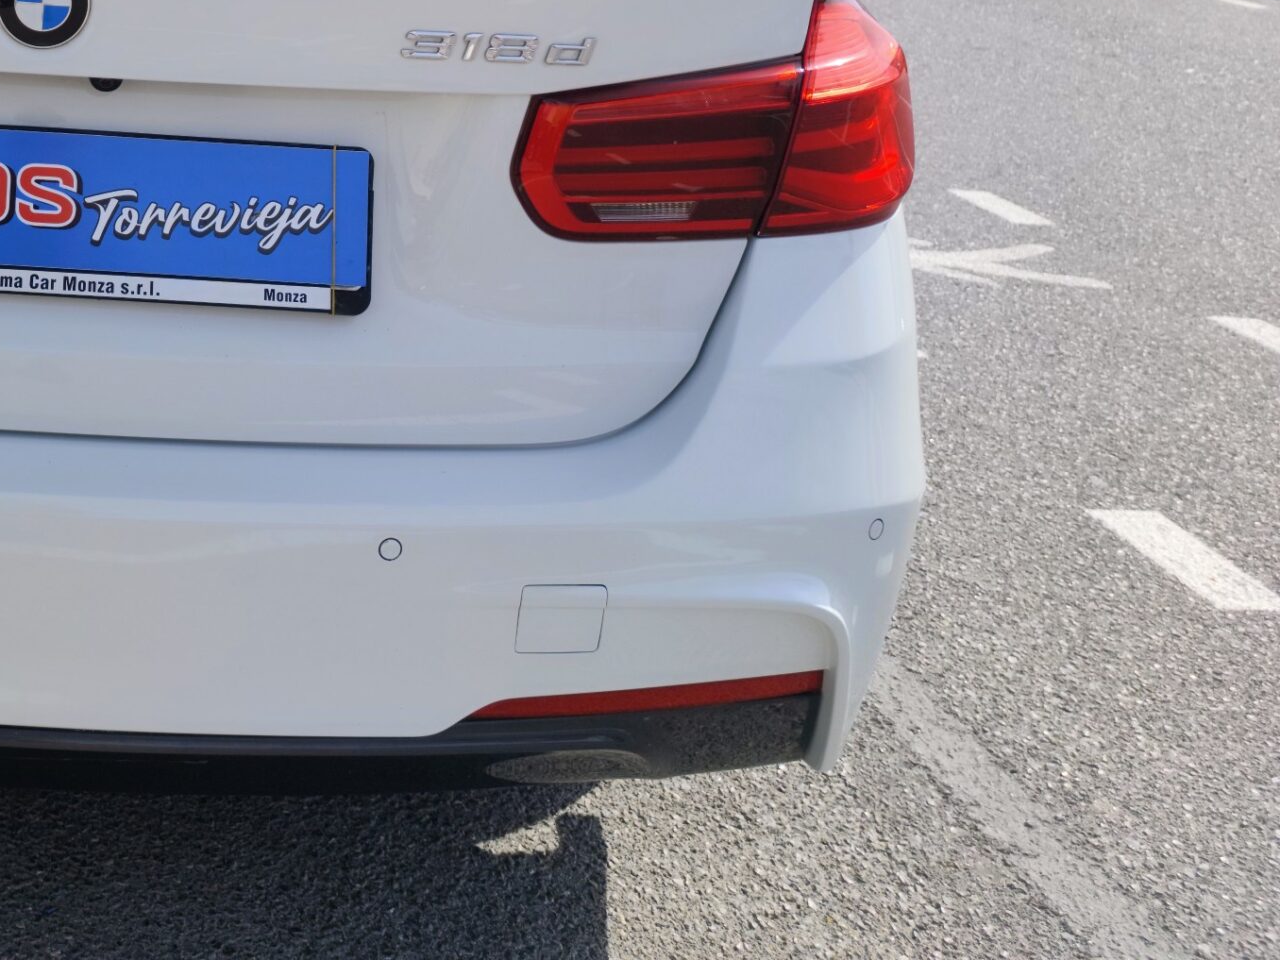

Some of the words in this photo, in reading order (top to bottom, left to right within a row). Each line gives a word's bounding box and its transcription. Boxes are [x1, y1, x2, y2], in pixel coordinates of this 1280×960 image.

[400, 29, 597, 66] 318d
[84, 189, 335, 251] Torrevieja
[29, 273, 57, 290] Car
[62, 275, 115, 294] Monza
[120, 280, 161, 297] s.r.l.
[263, 288, 308, 303] Monza
